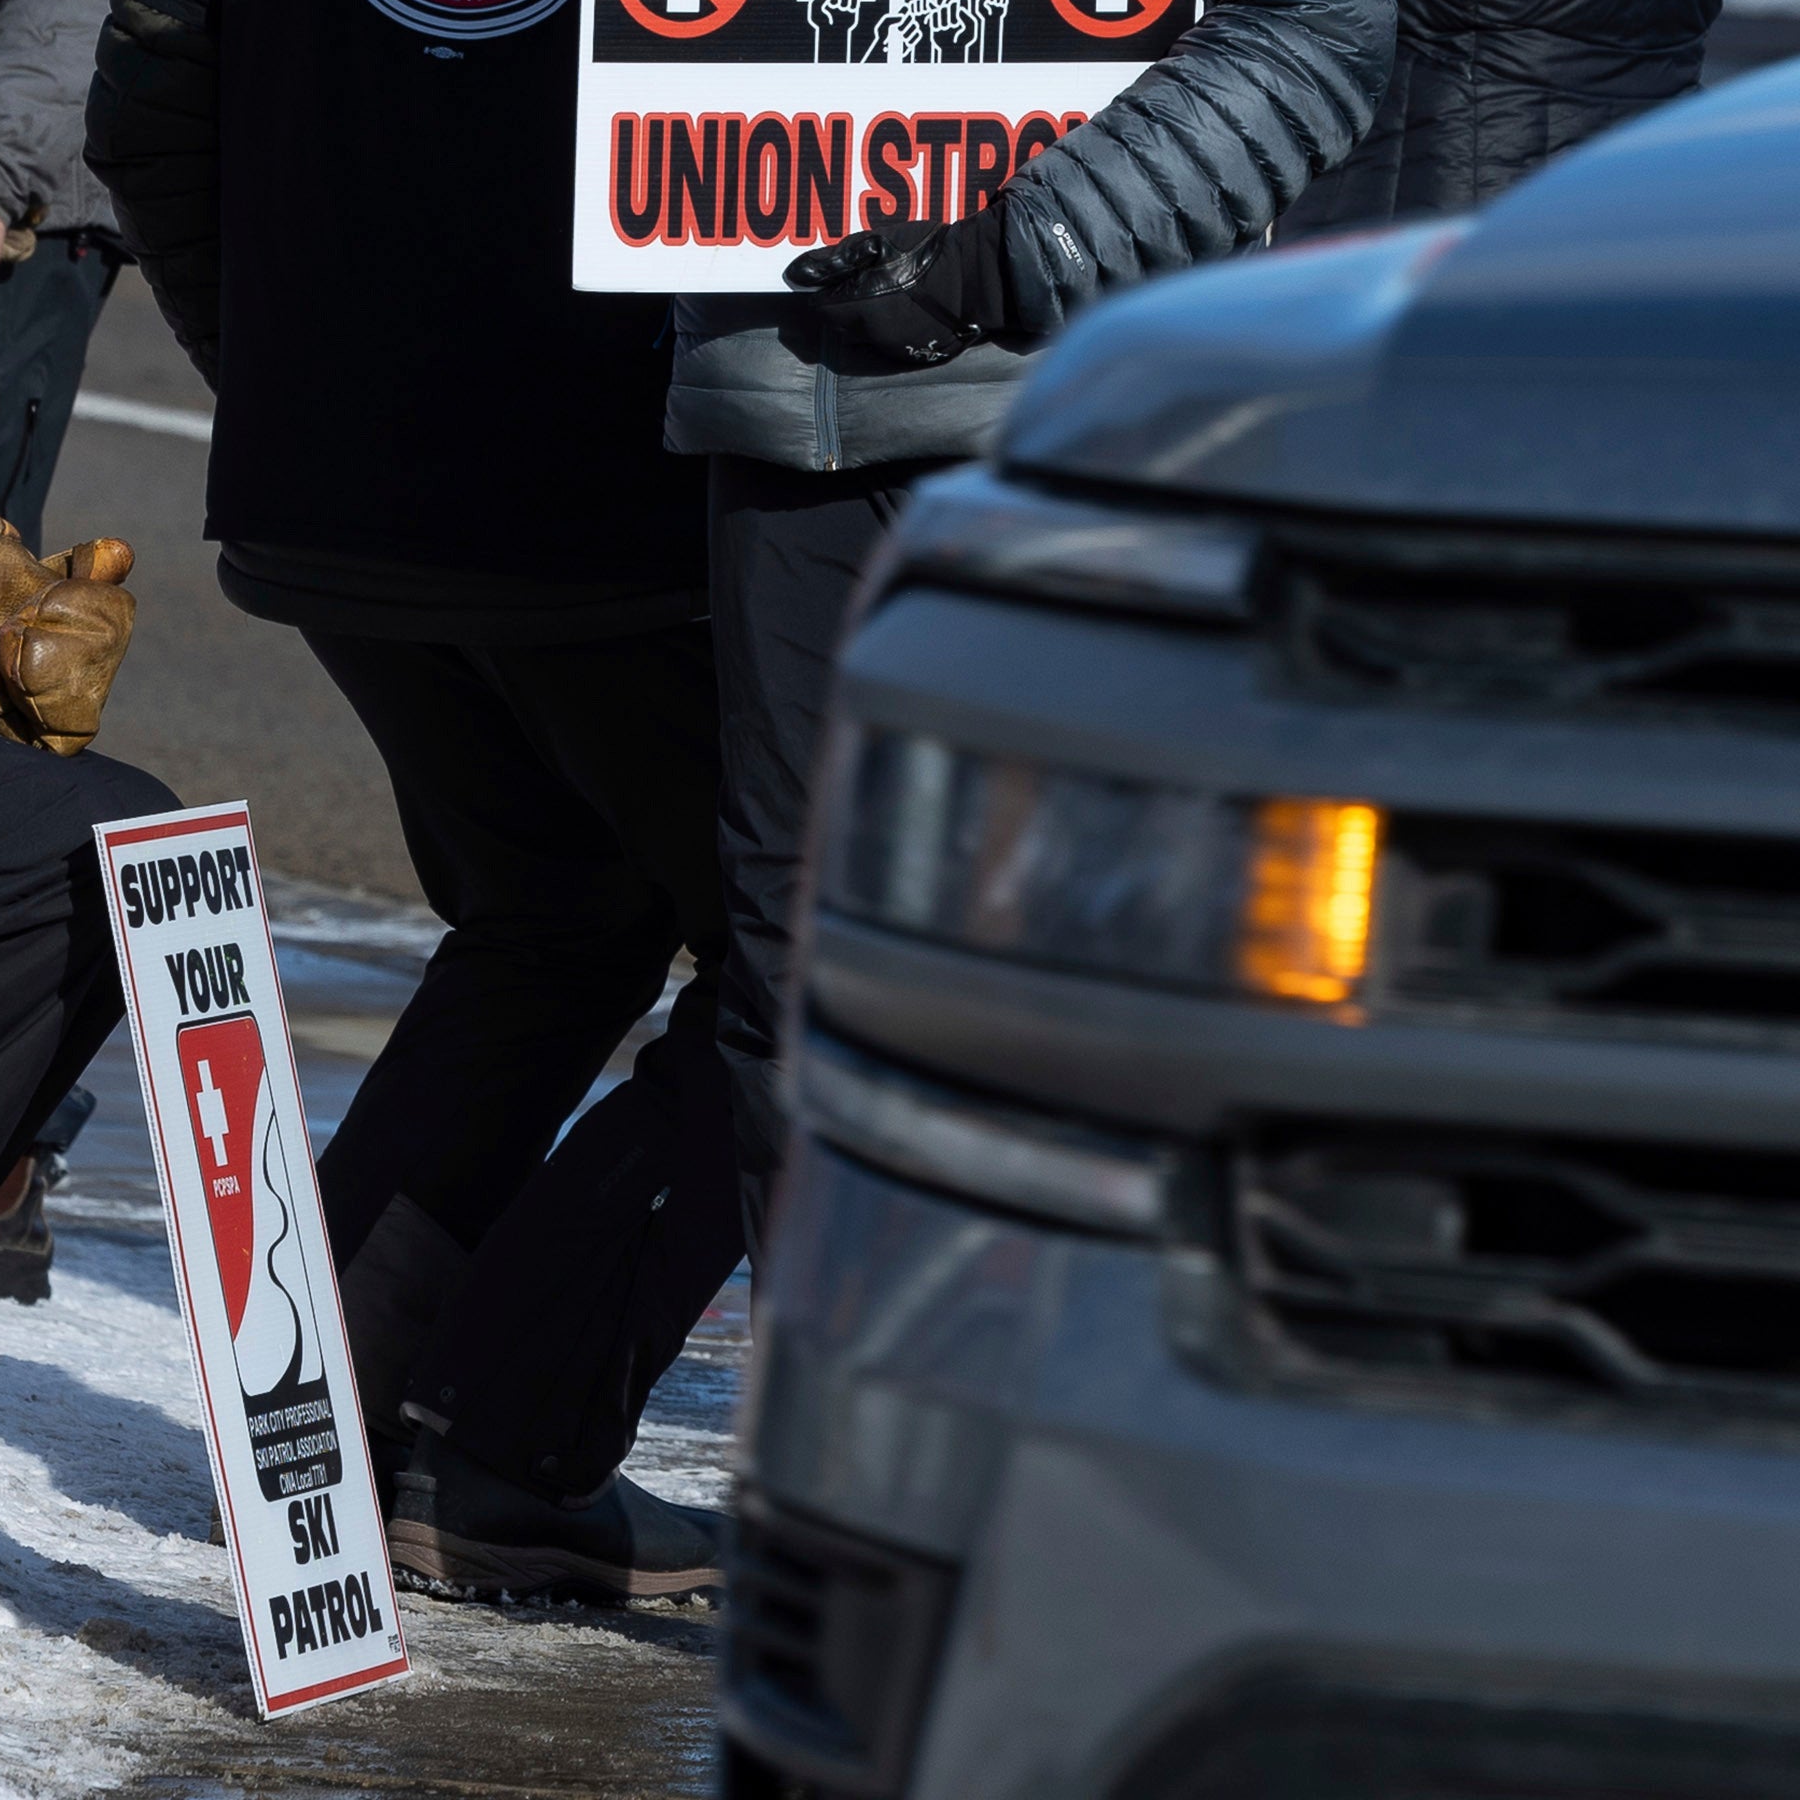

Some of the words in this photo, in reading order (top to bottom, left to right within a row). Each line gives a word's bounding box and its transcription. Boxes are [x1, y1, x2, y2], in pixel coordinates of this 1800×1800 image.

[610, 111, 854, 248] UNION
[1063, 232, 1086, 271] PERTEX
[120, 846, 254, 929] SUPPORT
[165, 942, 251, 1015] YOUR
[213, 1175, 241, 1198] PCPSPA
[248, 1413, 271, 1438] PARK
[269, 1409, 286, 1432] CITY
[284, 1398, 332, 1429] PROFESSIONAL
[255, 1447, 269, 1470] SKI
[268, 1441, 297, 1467] PATROL
[296, 1430, 337, 1459] ASSOCIATION
[295, 1466, 313, 1490] Local
[288, 1492, 340, 1565] SKI
[268, 1571, 384, 1660] PATROL
